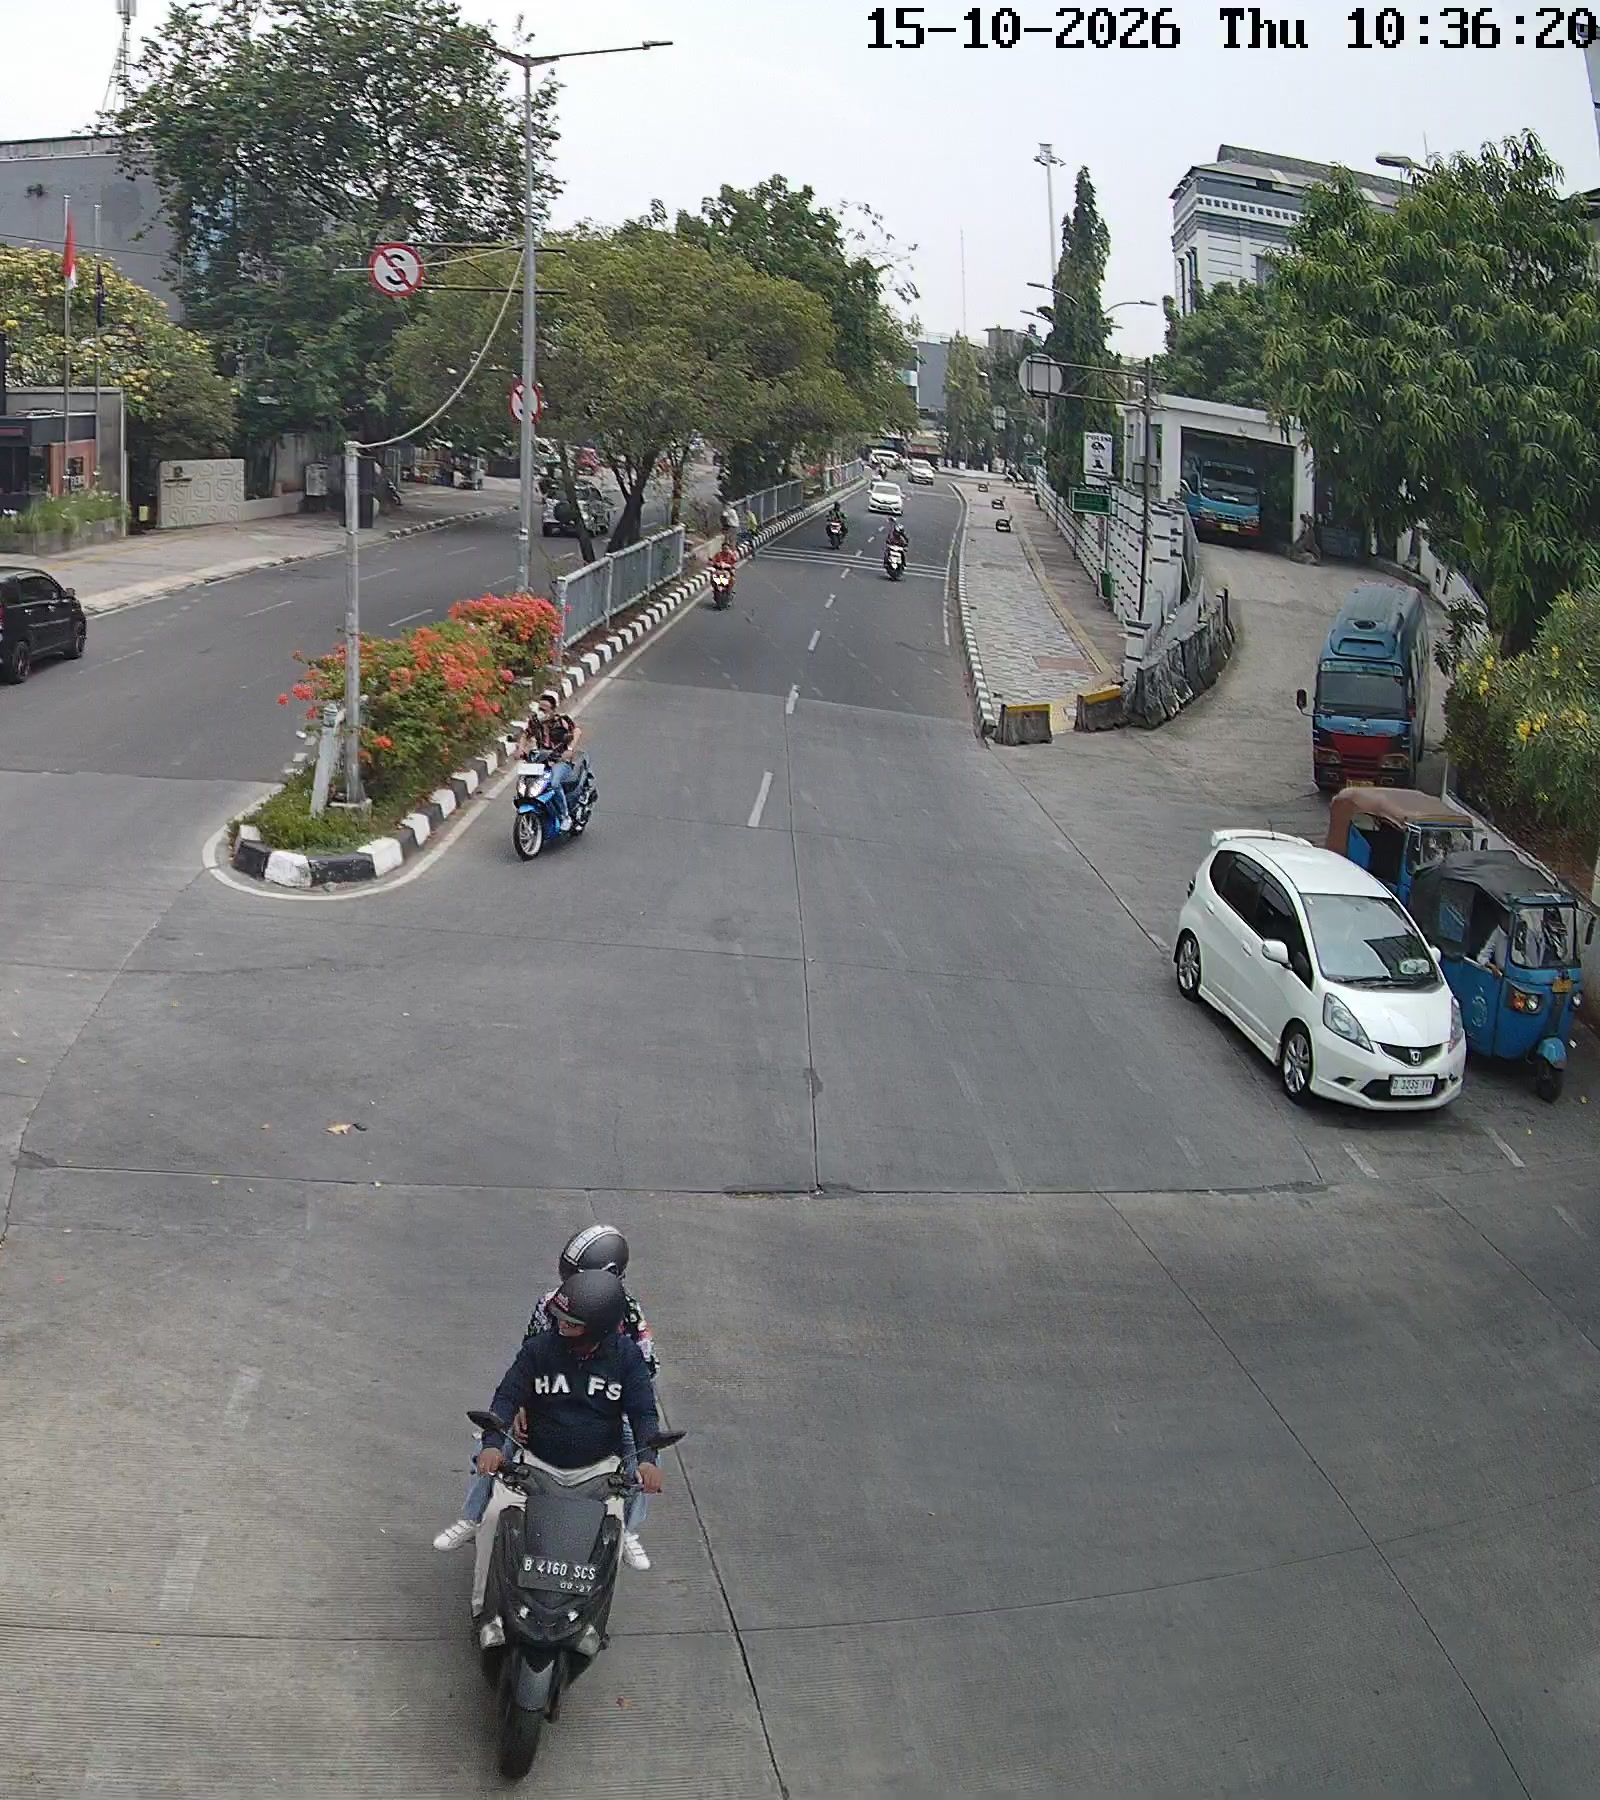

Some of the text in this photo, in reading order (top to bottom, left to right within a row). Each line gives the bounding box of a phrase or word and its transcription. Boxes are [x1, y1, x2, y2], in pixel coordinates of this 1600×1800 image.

[524, 1557, 597, 1581] B 4160 SCS
